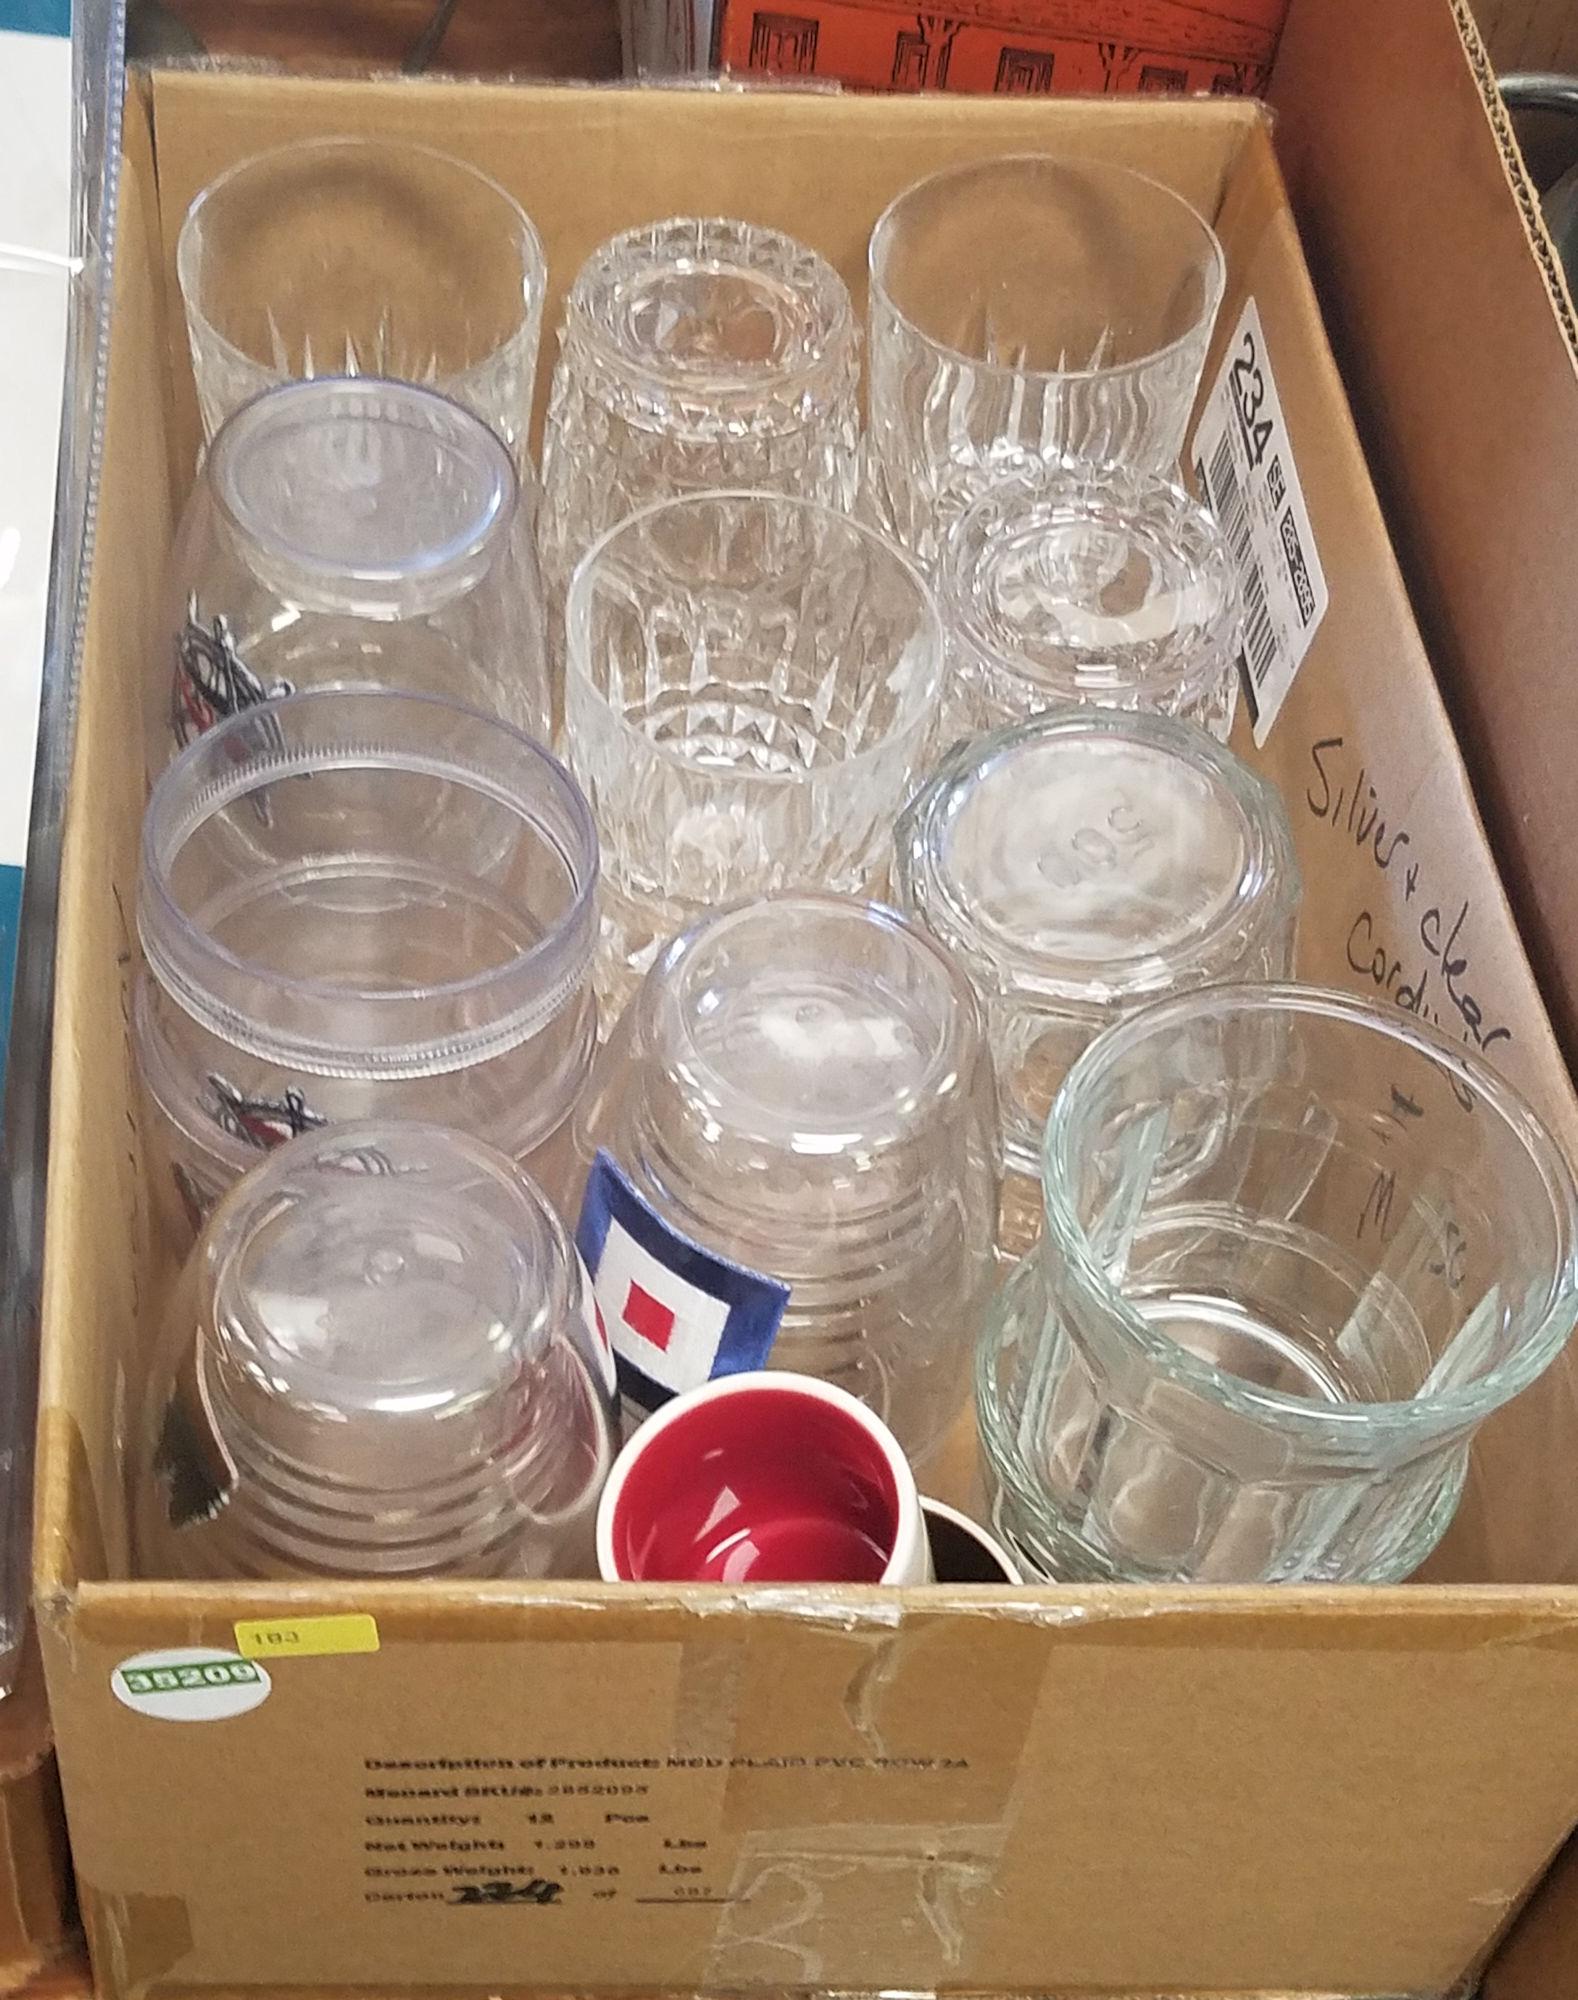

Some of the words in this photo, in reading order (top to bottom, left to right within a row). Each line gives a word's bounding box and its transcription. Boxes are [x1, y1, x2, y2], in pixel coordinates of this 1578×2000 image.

[1233, 331, 1273, 467] 234
[1307, 738, 1409, 869] Silver
[520, 1758, 546, 1769] of
